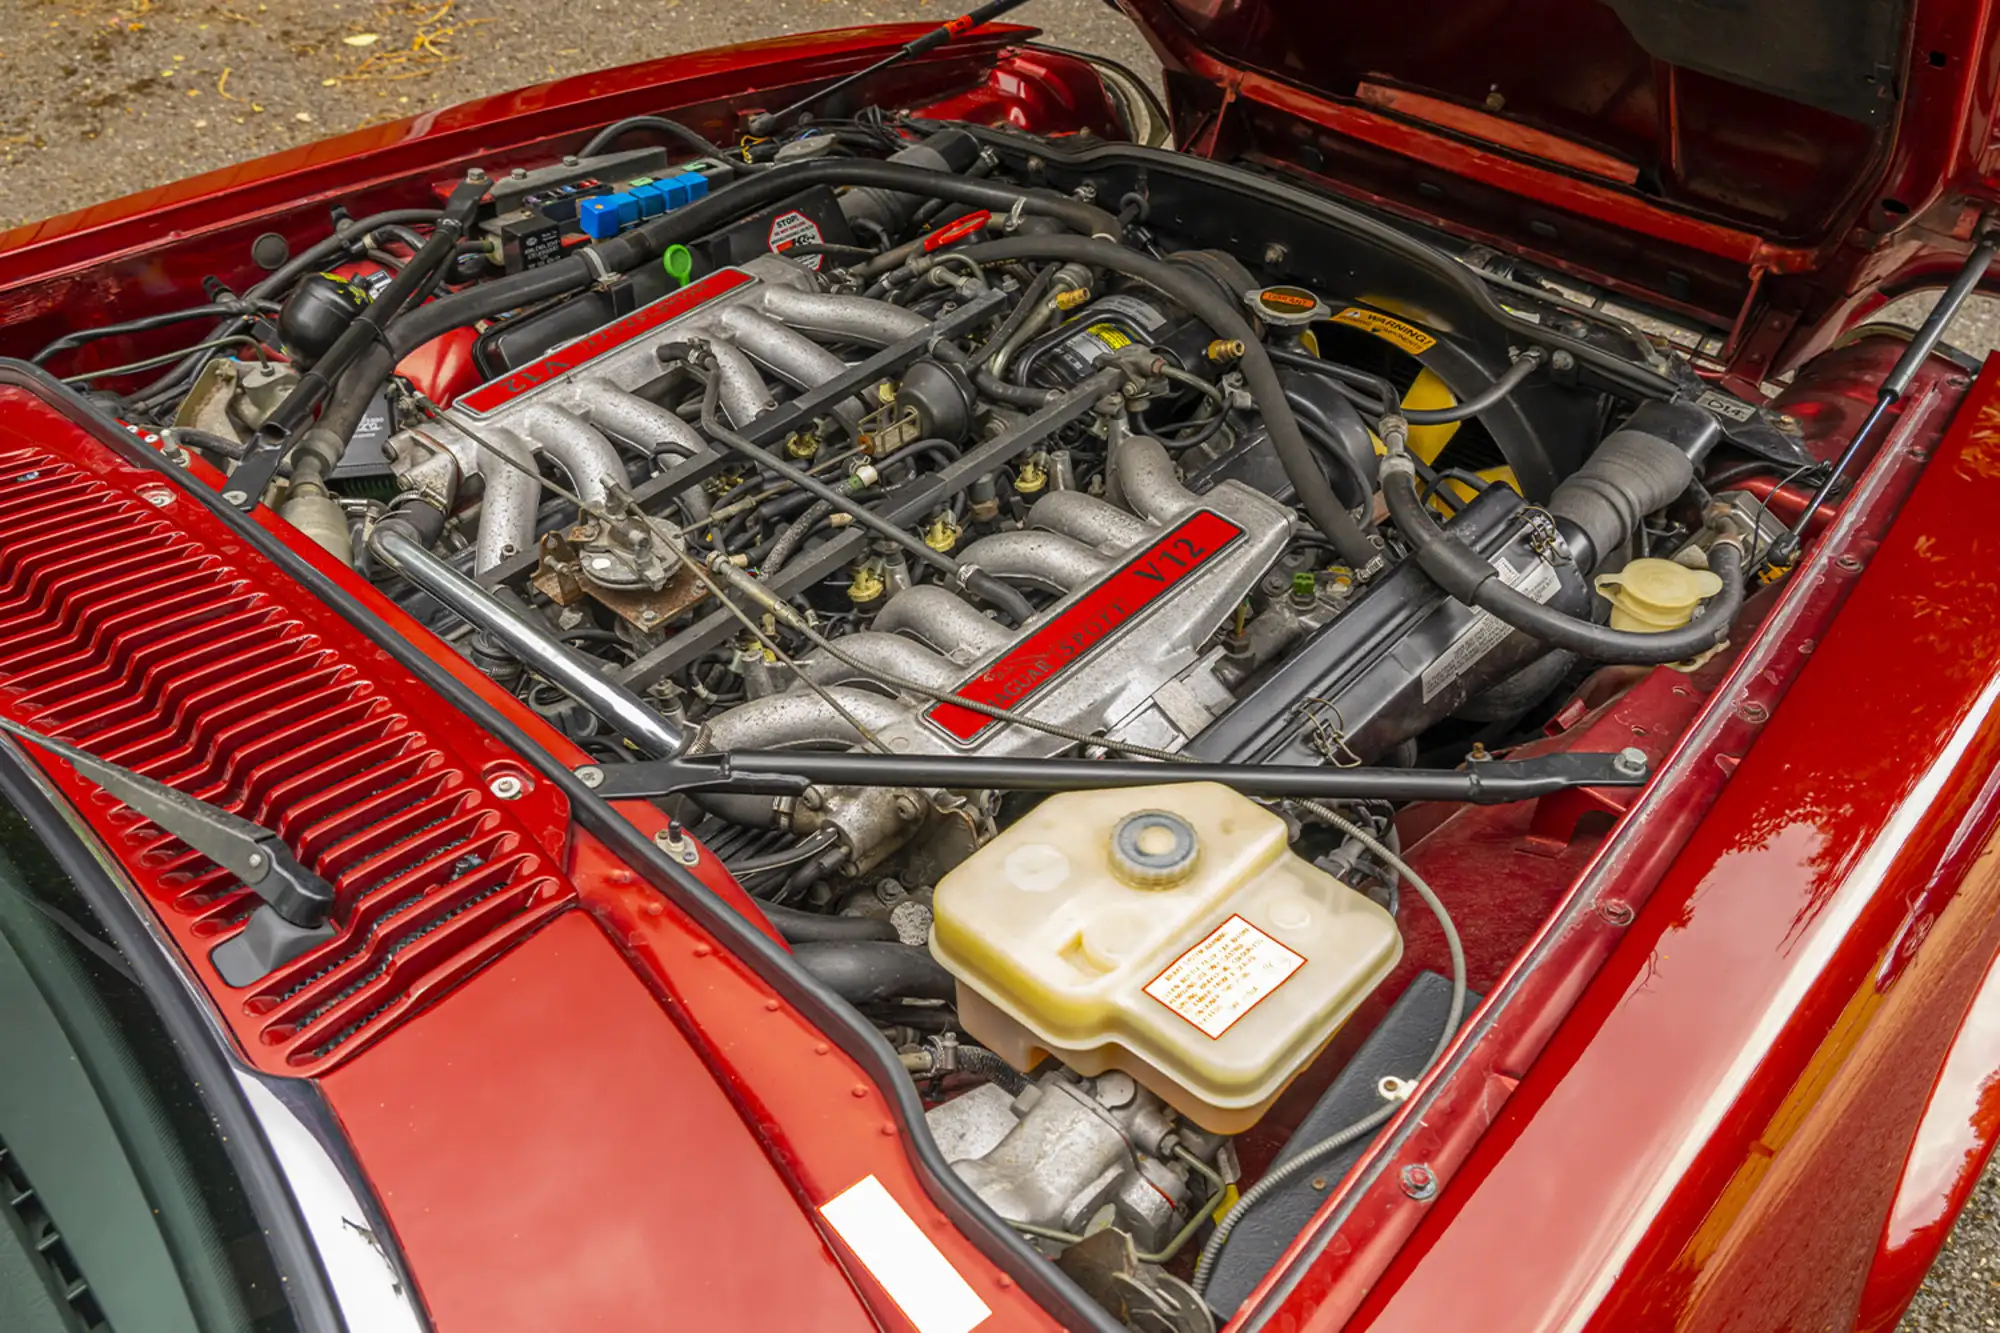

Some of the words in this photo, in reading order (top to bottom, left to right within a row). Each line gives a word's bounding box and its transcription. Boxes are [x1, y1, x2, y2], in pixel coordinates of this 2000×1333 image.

[776, 214, 799, 228] STOP!
[500, 361, 569, 392] V12
[1133, 537, 1205, 582] V12
